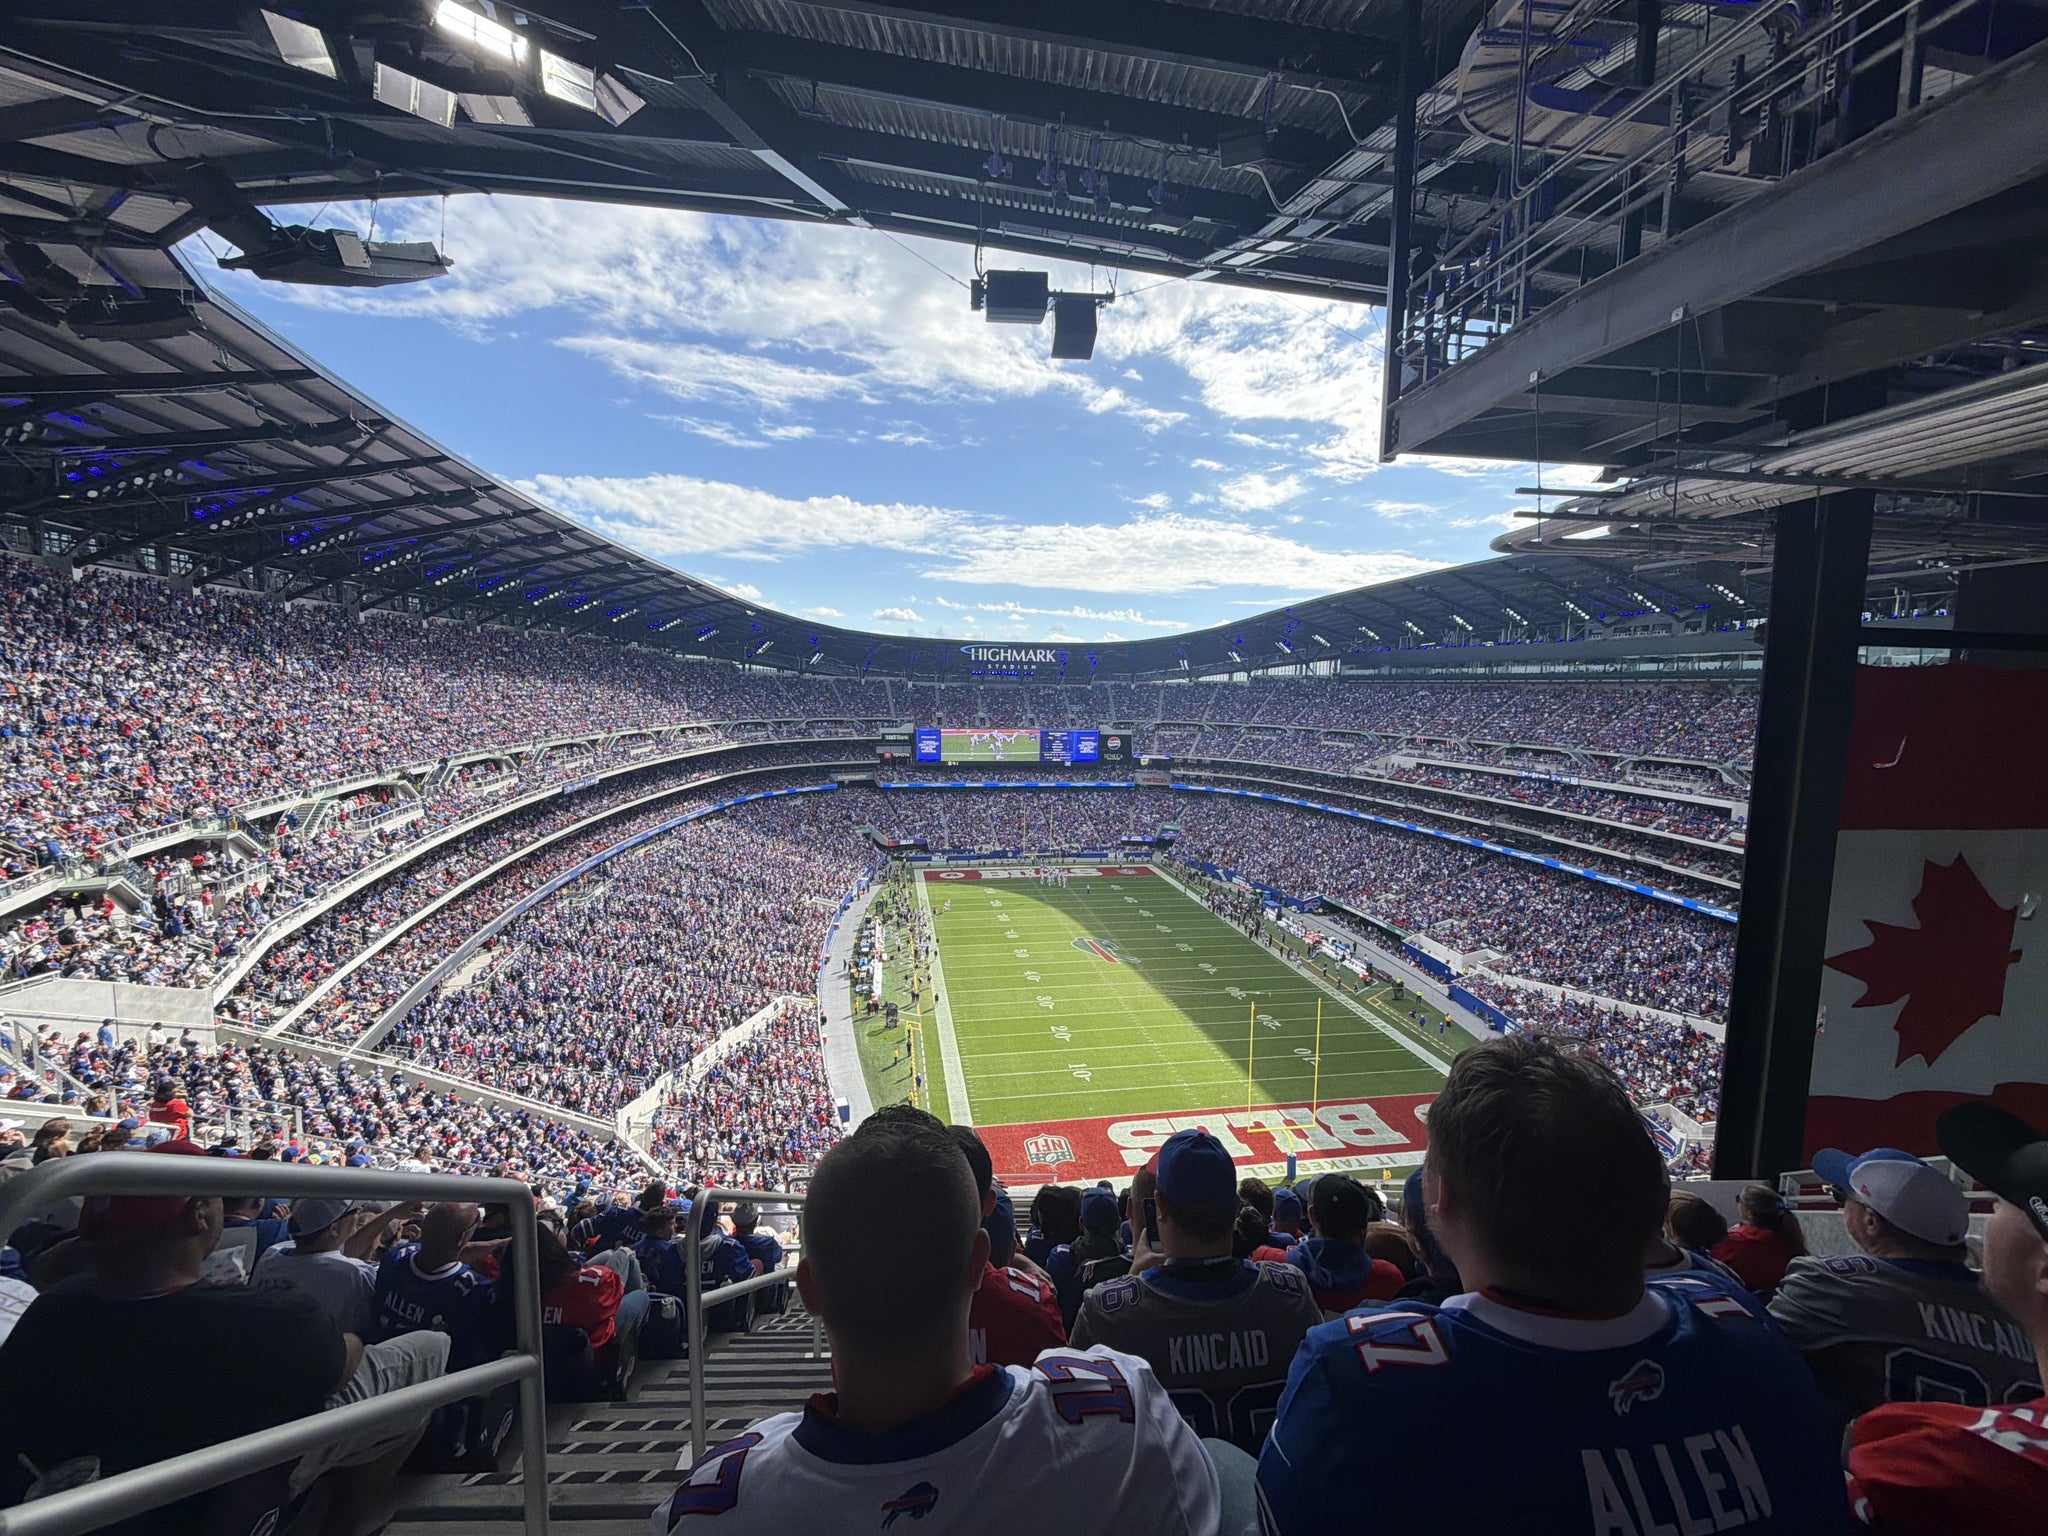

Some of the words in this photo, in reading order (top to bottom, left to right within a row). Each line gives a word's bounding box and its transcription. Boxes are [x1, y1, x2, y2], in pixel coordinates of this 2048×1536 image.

[971, 648, 1056, 662] HIGHMARK
[1140, 776, 1168, 784] verizon
[1036, 995, 1055, 1010] 30
[1256, 1014, 1282, 1031] 20
[1050, 1025, 1072, 1042] 20
[1294, 1048, 1322, 1066] 10
[1068, 1063, 1092, 1082] 10
[1107, 1103, 1412, 1168] BILLS
[1029, 1138, 1068, 1154] NFL
[1299, 1157, 1365, 1173] TAKES
[1375, 1154, 1399, 1167] IT
[1242, 1164, 1288, 1178] ALL
[621, 1226, 648, 1247] ALLEN
[453, 1270, 480, 1297] 17
[1007, 1266, 1041, 1304] 17
[383, 1290, 426, 1325] ALLEN
[1345, 1310, 1454, 1376] 17
[1167, 1329, 1271, 1376] KINCAID
[1035, 1355, 1136, 1425] 17
[1580, 1422, 1773, 1536] ALLEN
